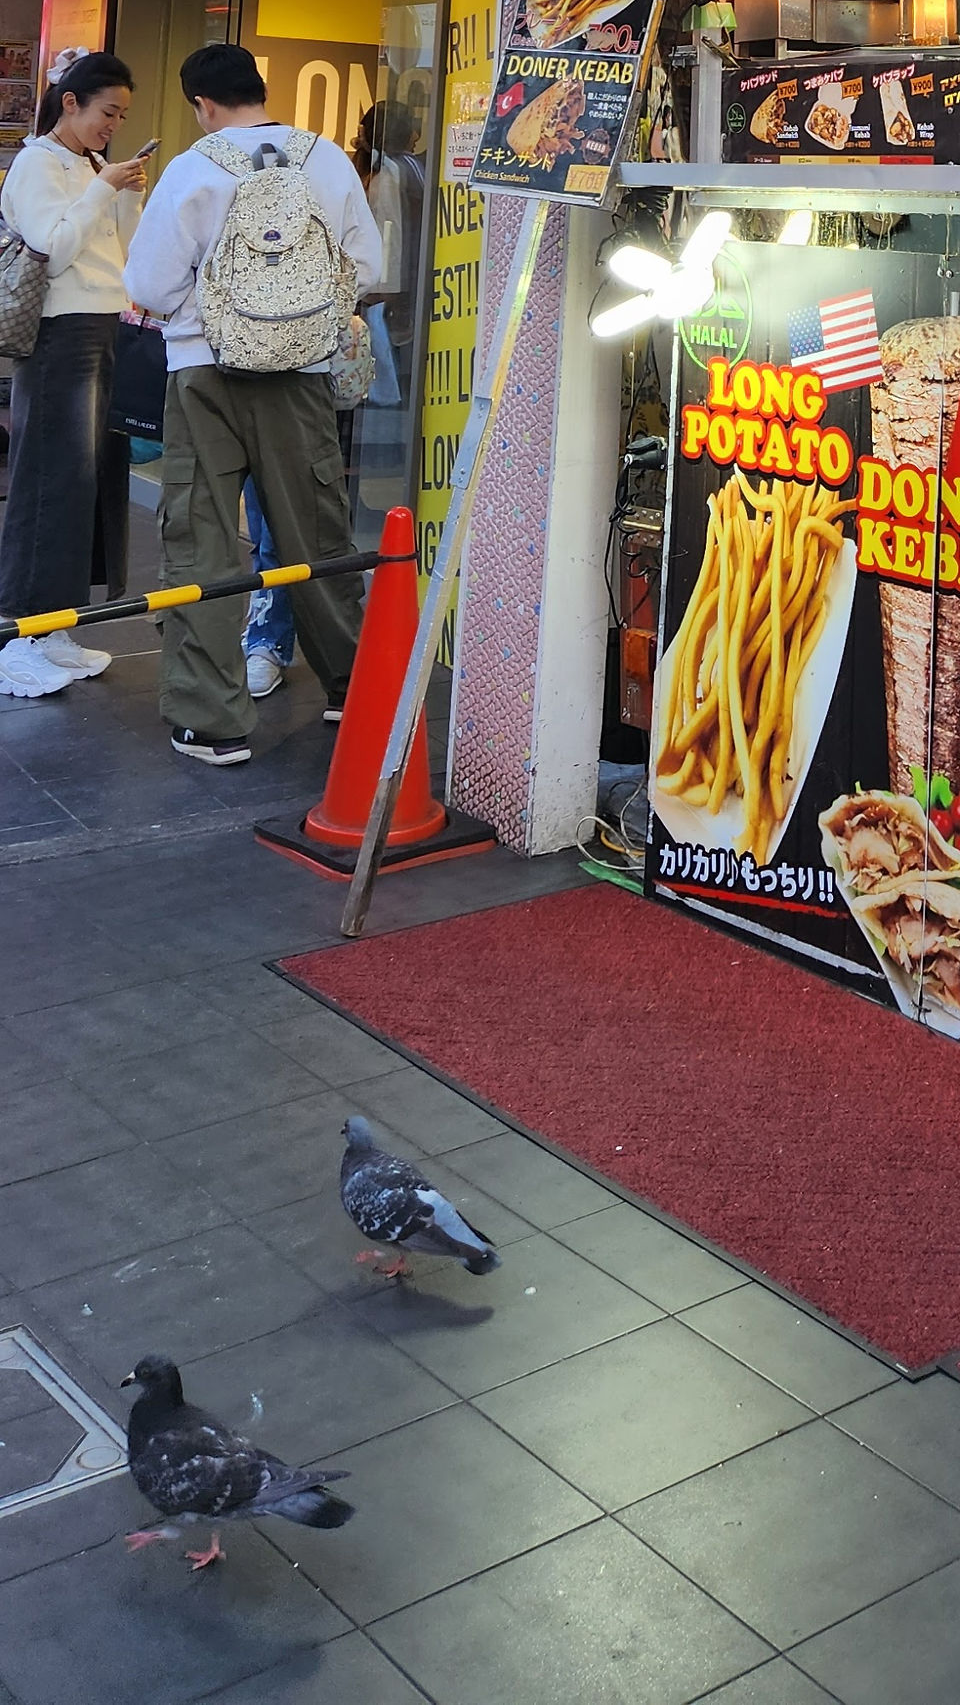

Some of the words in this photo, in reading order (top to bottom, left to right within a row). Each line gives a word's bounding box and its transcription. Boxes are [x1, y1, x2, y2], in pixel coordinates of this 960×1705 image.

[506, 55, 569, 81] DONER
[573, 59, 634, 83] KEBAB
[803, 68, 845, 90] つまみケバブ
[873, 63, 915, 88] ケバブラップ
[780, 84, 796, 95] ¥700
[844, 82, 861, 94] ¥700
[913, 79, 932, 91] ¥900
[586, 140, 606, 153] KEBAB
[480, 148, 556, 171] チキンサンド
[474, 169, 498, 180] Chicken
[499, 172, 530, 183] Sandwich
[690, 324, 737, 348] HALAL
[709, 361, 825, 421] LONG
[684, 410, 850, 480] POTATO
